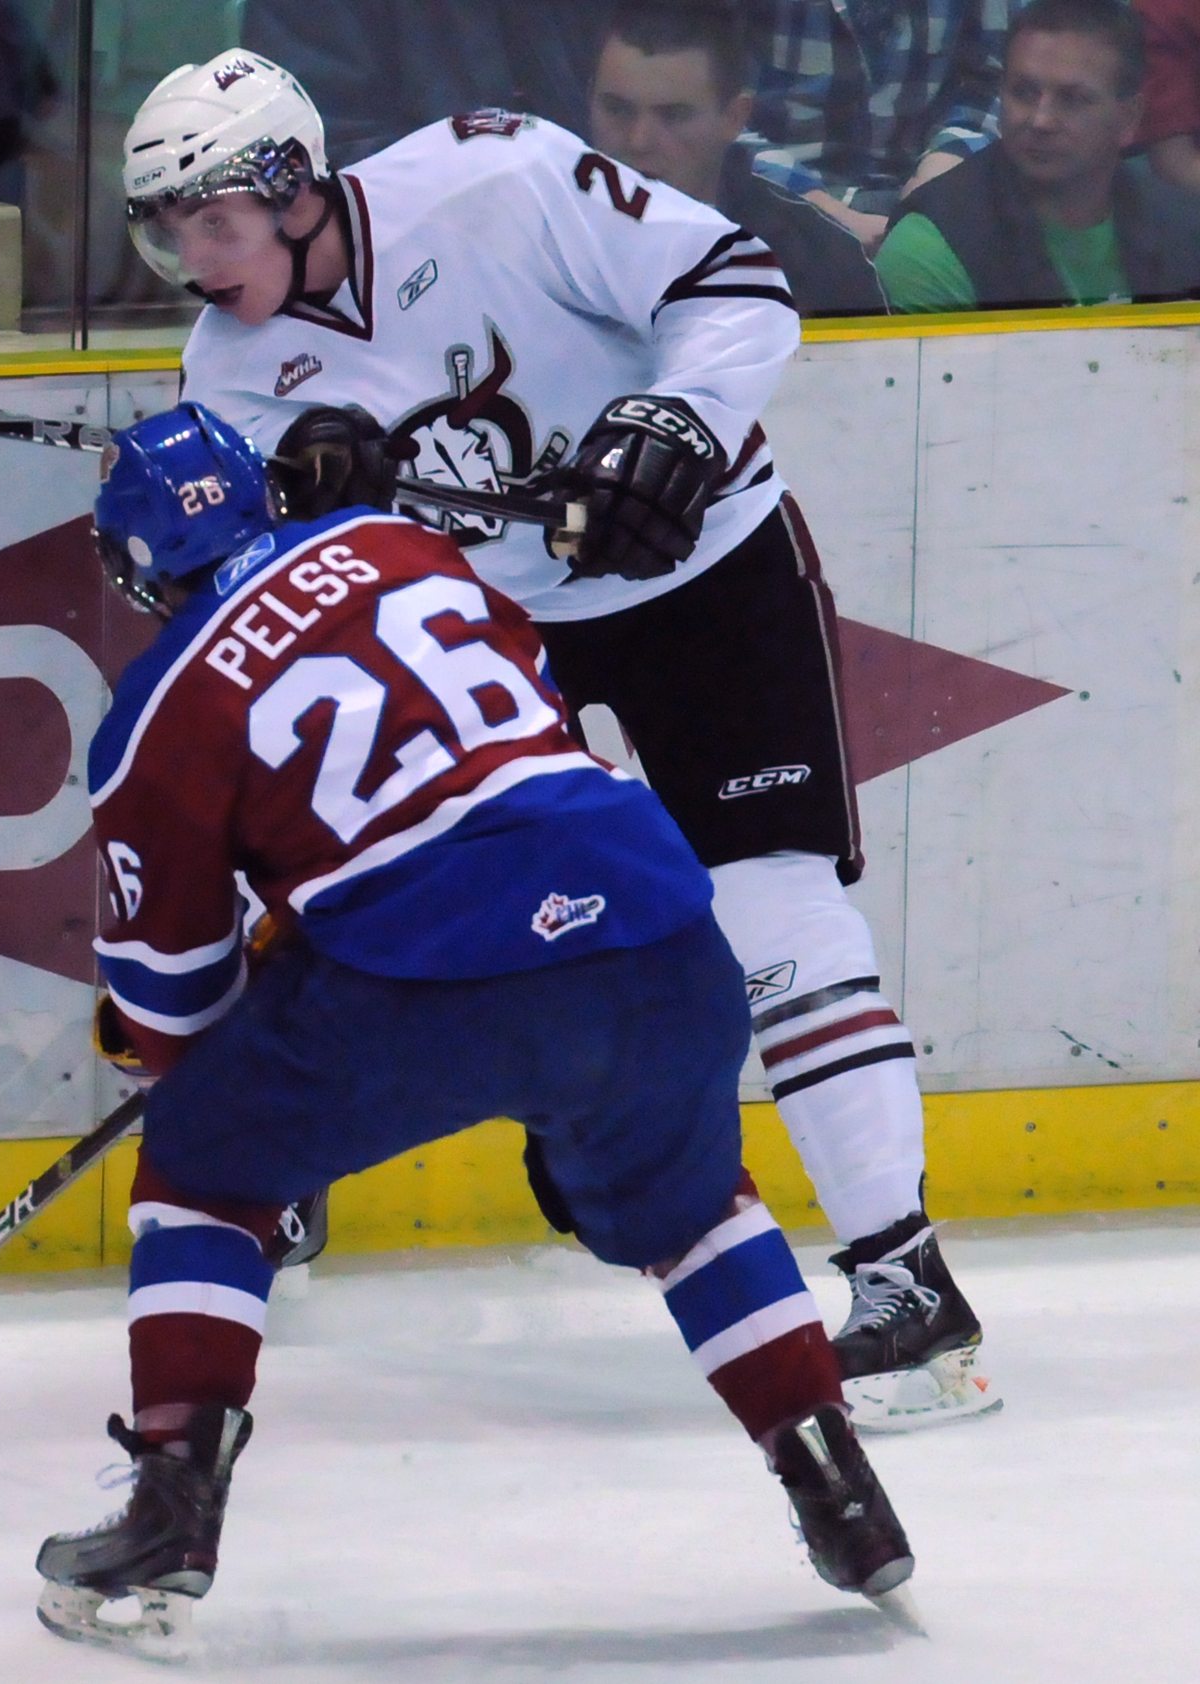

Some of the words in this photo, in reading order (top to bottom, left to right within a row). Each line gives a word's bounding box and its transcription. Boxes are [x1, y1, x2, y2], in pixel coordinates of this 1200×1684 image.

[134, 171, 162, 186] CCM
[281, 356, 320, 386] WHL
[619, 400, 709, 455] CCM
[177, 475, 225, 516] 26
[205, 544, 380, 690] PELSS
[248, 573, 560, 845] 26
[727, 770, 804, 793] CCM
[98, 840, 143, 921] 6
